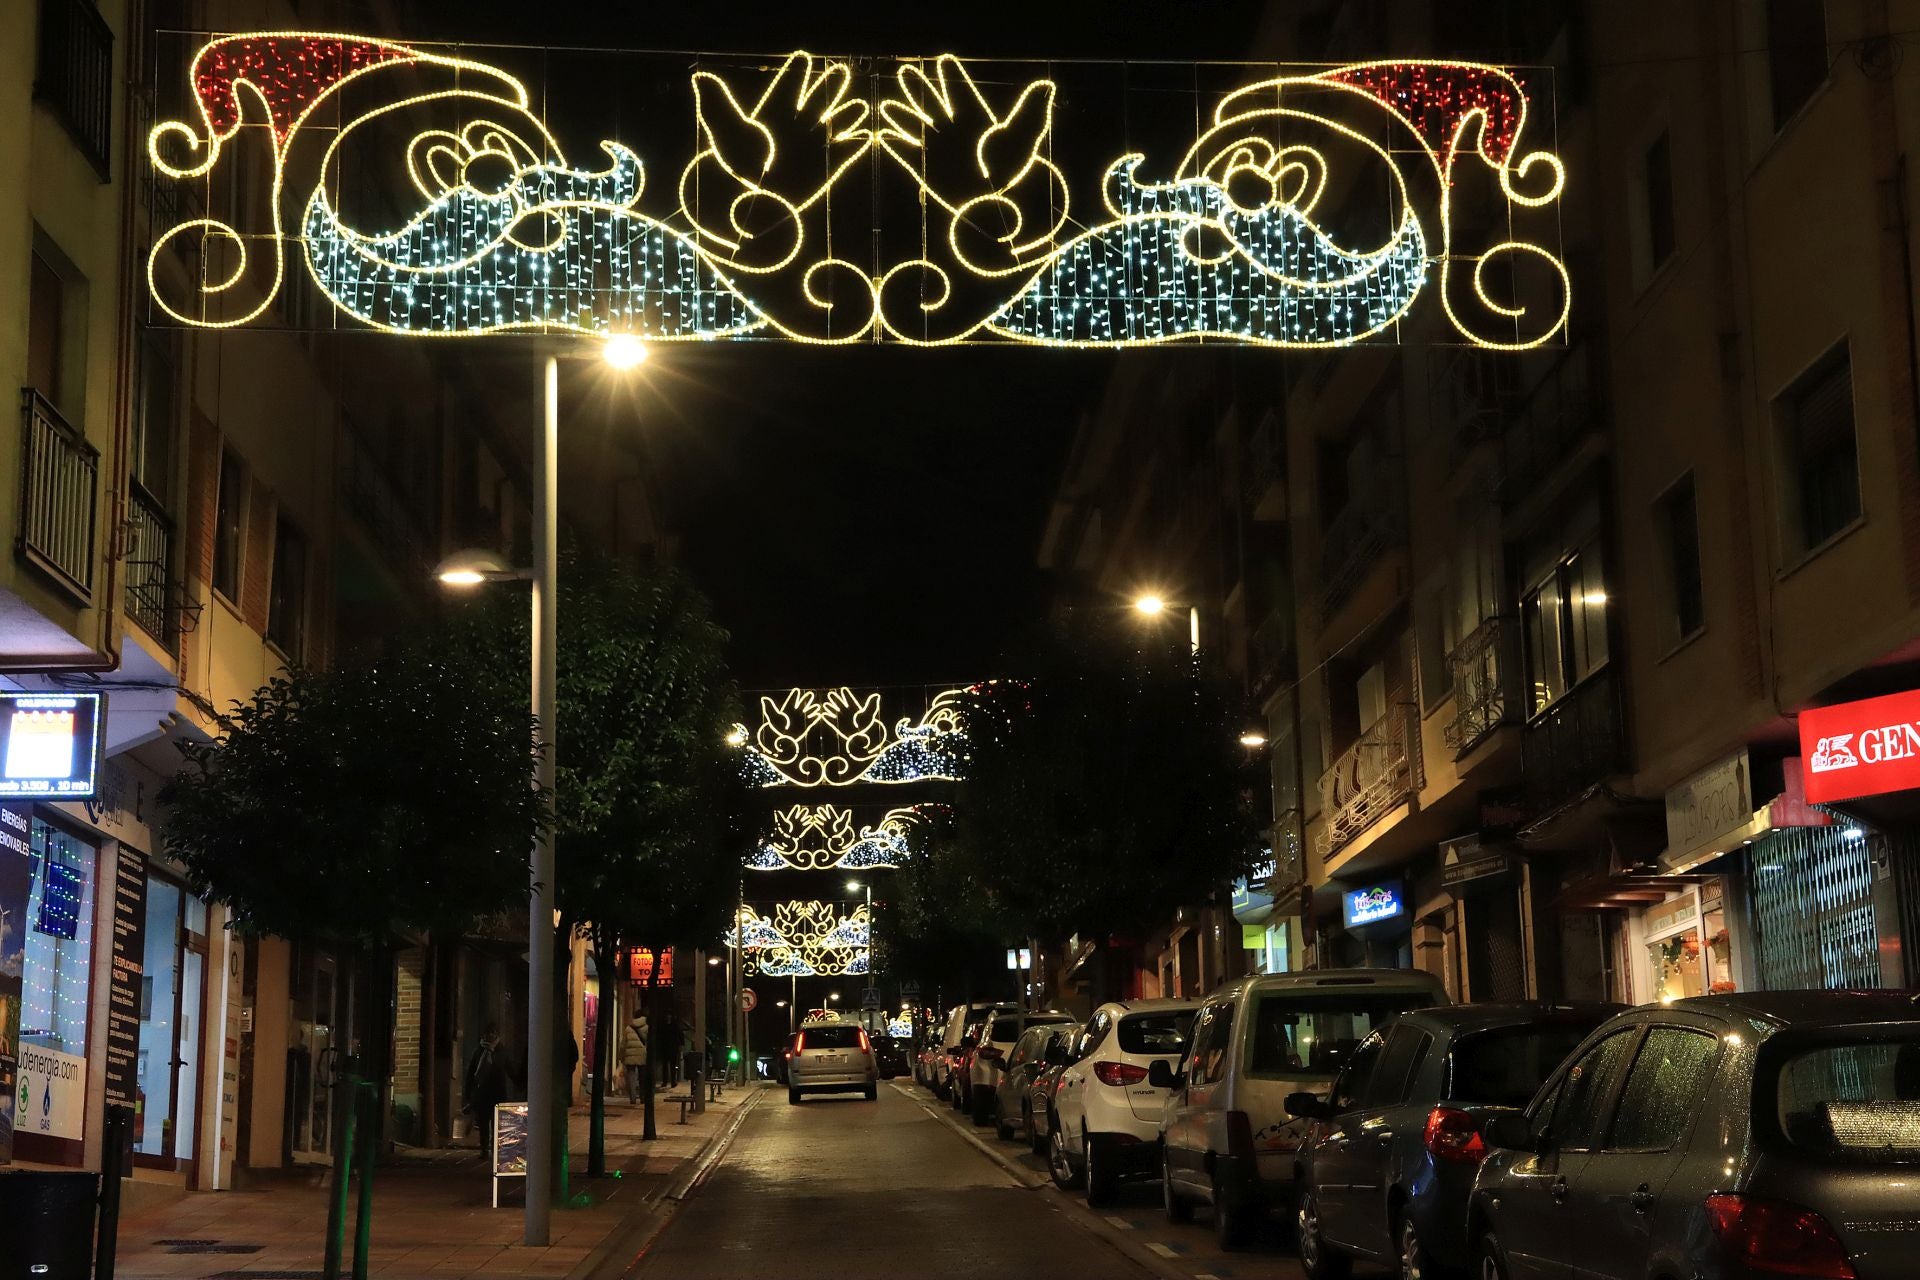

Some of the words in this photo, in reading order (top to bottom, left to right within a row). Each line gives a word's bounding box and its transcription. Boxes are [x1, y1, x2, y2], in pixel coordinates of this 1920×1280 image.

[1858, 721, 1920, 764] GEN
[1, 808, 28, 833] ENERGÍAS
[633, 957, 670, 966] FOTOGIA
